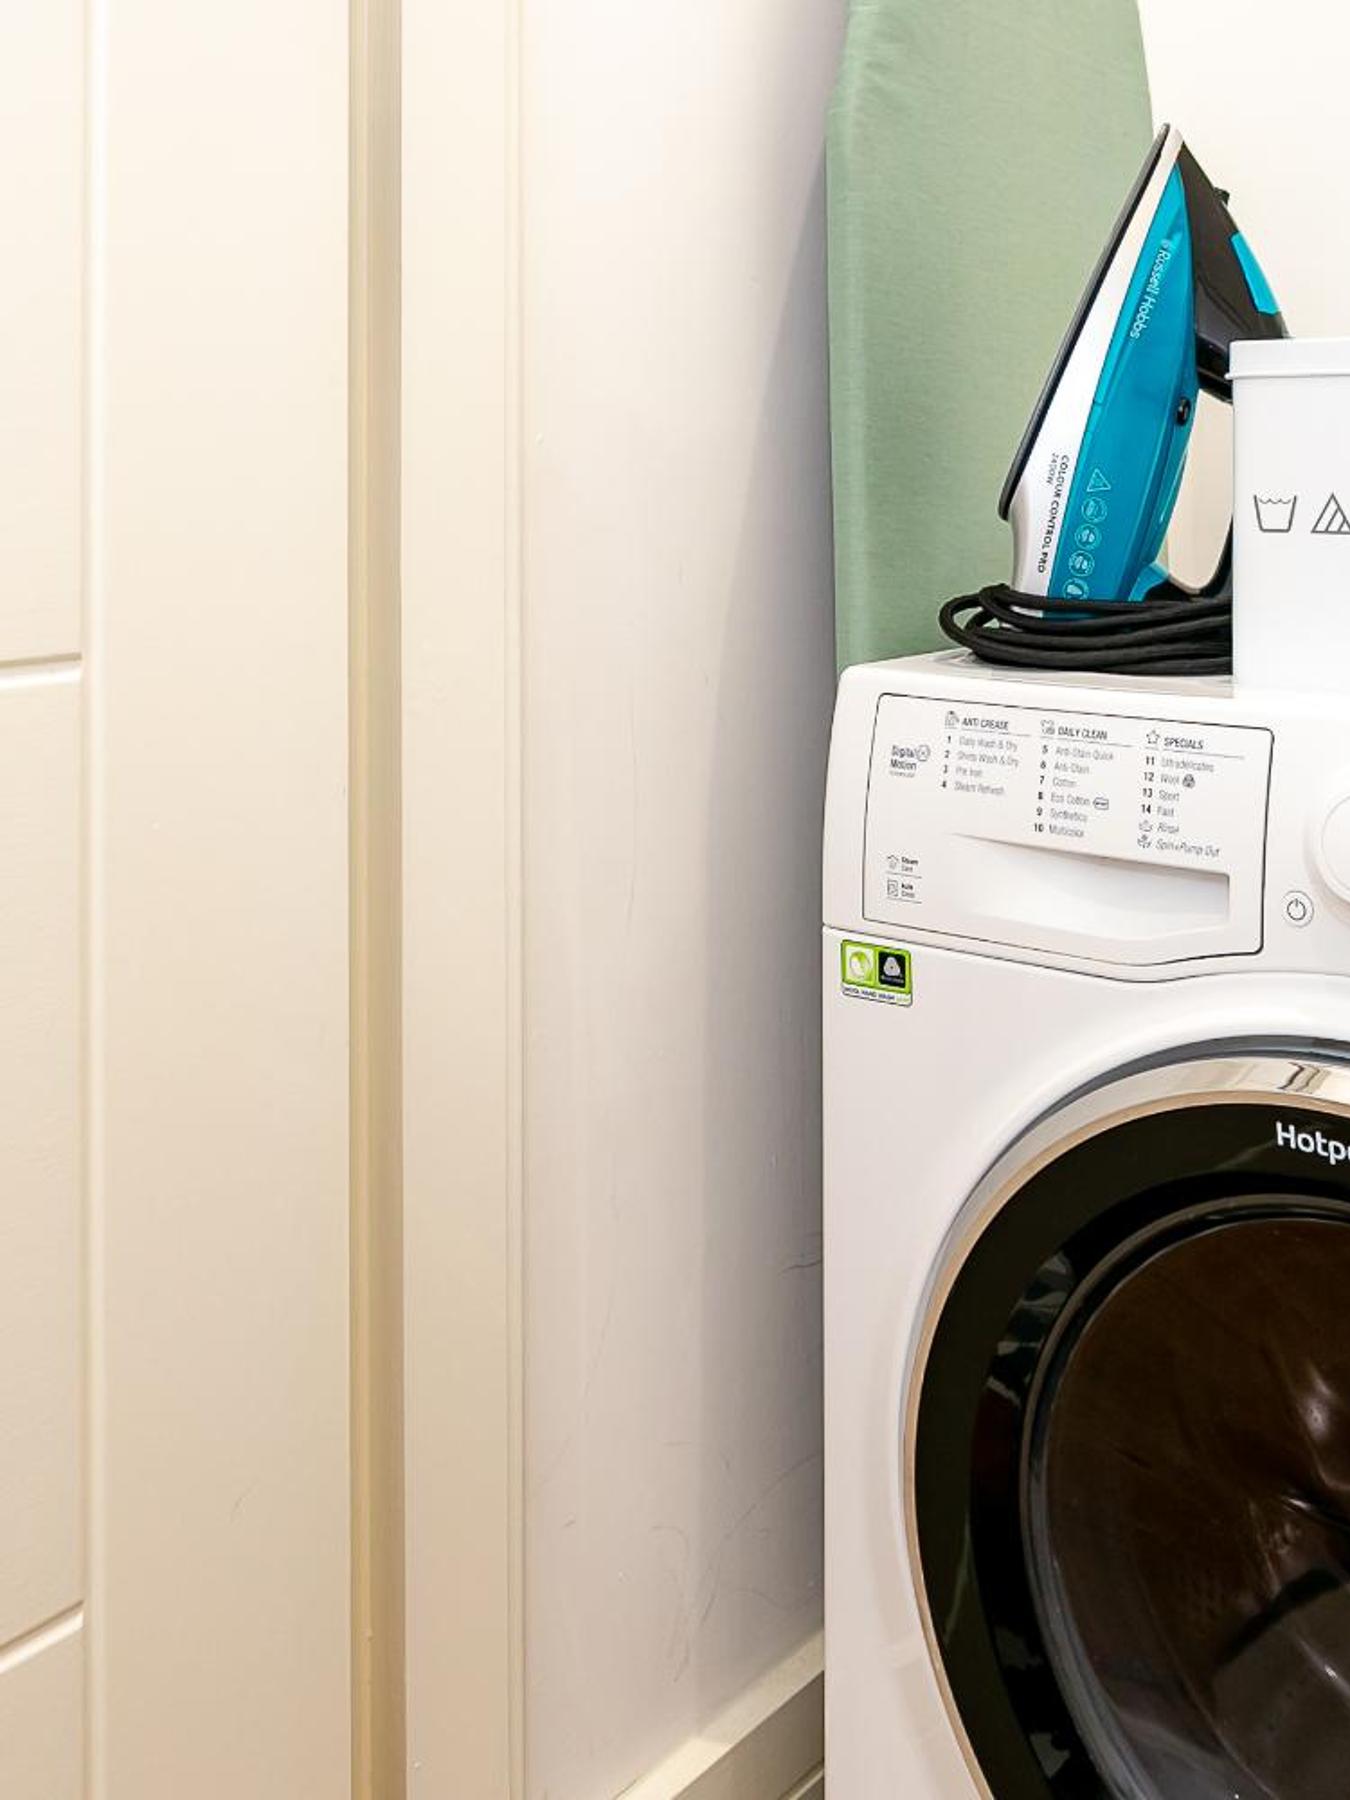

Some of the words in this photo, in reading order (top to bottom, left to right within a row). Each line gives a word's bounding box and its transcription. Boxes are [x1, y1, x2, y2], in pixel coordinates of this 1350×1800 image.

[1146, 249, 1172, 295] Russell
[1130, 295, 1157, 340] Hobbs
[1054, 454, 1071, 498] COLOUR
[1041, 500, 1060, 550] CONTROL
[1037, 552, 1049, 574] PRO
[961, 717, 979, 728] ANTI
[1058, 726, 1080, 738] DAILY
[1081, 728, 1108, 740] CLEAN
[1164, 737, 1204, 750] SPECIALS
[1042, 744, 1048, 754] 5
[944, 750, 950, 759] 2
[890, 758, 917, 771] Motion
[1146, 756, 1155, 765] 11
[1039, 775, 1045, 784] 7
[1144, 772, 1154, 782] 12
[1143, 788, 1153, 798] 13
[1036, 806, 1043, 816] 9
[1142, 804, 1151, 814] 14
[1034, 823, 1044, 832] 10
